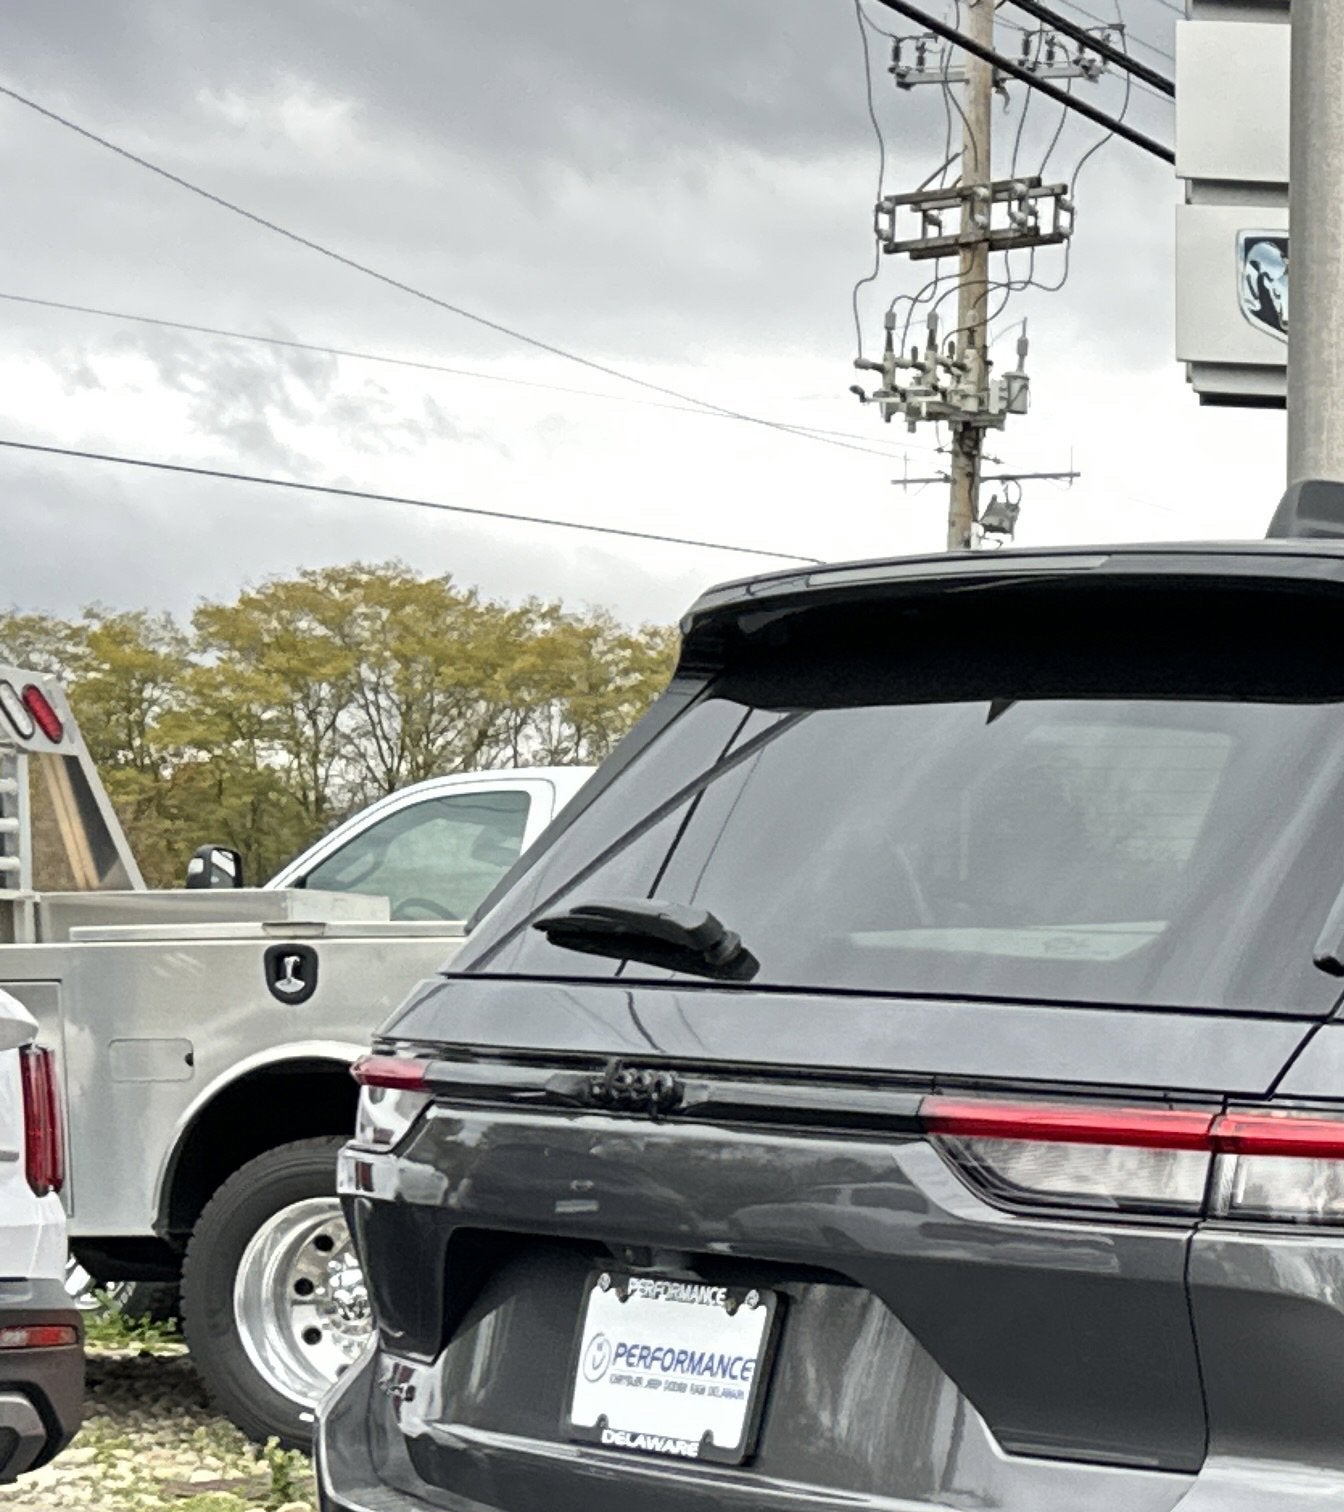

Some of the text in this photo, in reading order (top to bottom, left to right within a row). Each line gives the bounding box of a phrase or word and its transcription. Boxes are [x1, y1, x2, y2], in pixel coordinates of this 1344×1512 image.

[627, 1277, 728, 1306] PERFORMANCE
[612, 1342, 757, 1382] PERFORMANCE
[601, 1429, 700, 1458] DELAWARE
